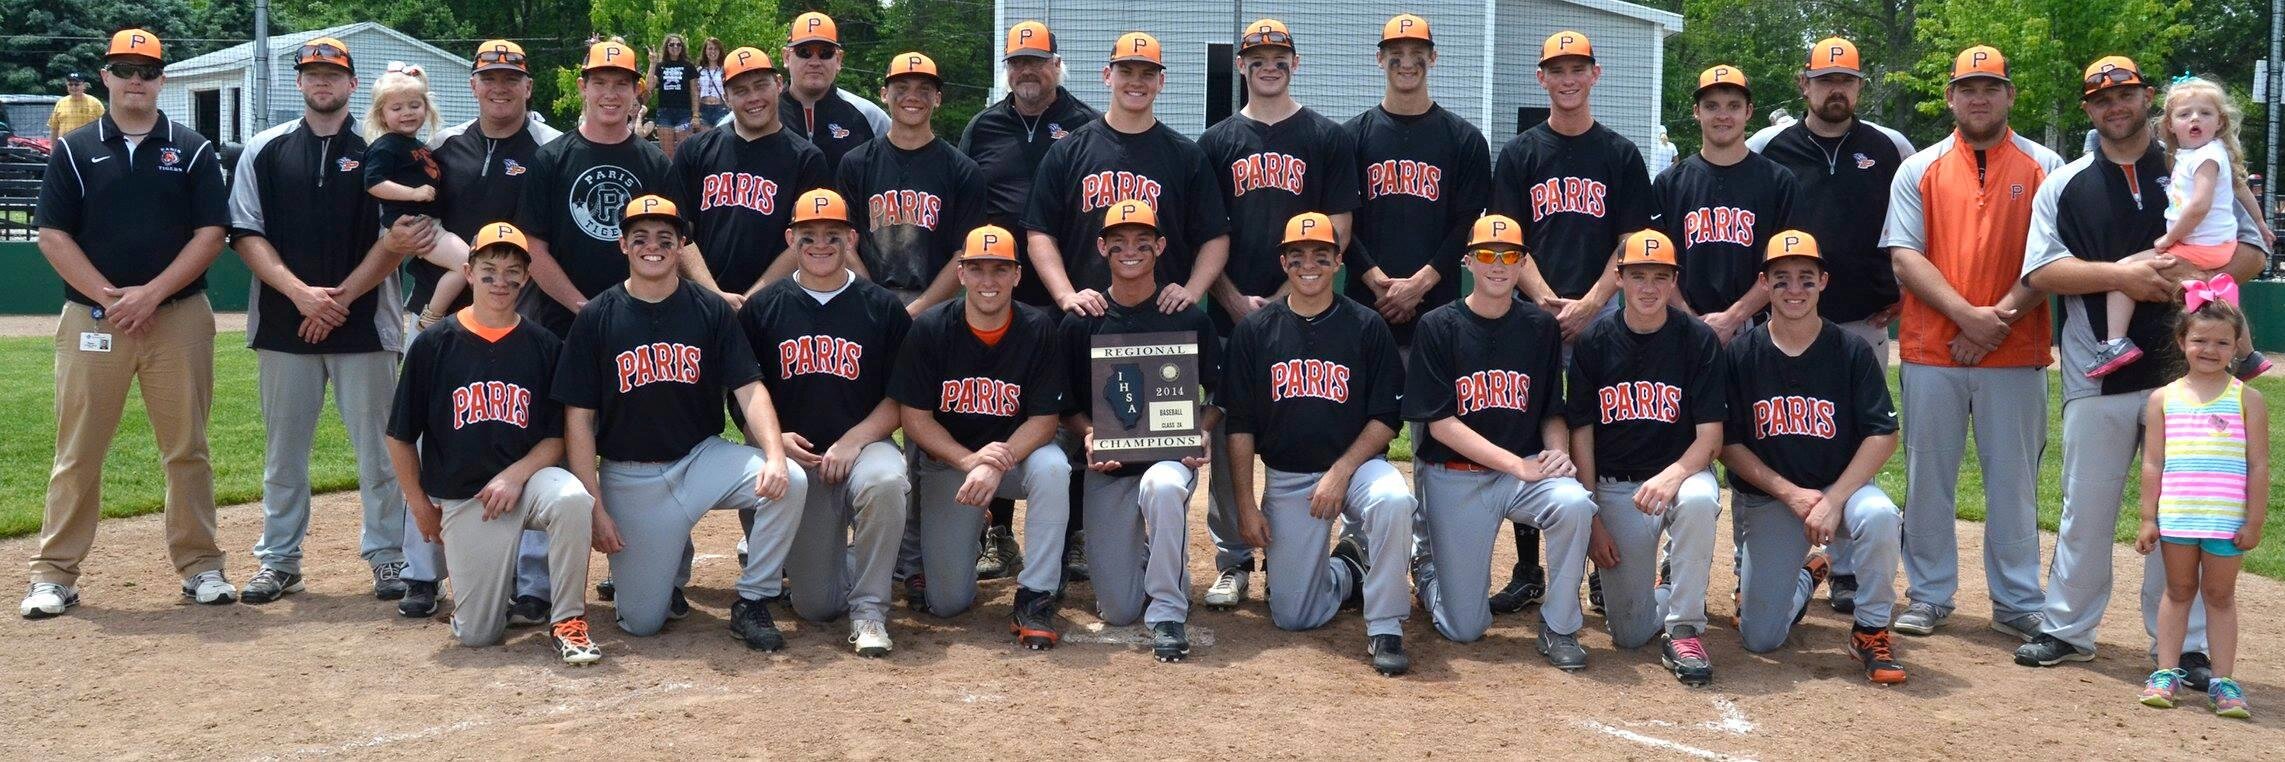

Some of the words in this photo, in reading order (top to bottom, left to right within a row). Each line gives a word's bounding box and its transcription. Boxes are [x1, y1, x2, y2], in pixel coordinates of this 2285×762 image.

[808, 18, 820, 32] P
[1400, 20, 1412, 33] P
[131, 35, 146, 48] P
[1020, 30, 1033, 44] P
[1134, 38, 1146, 52] P
[1560, 37, 1574, 50] P
[607, 47, 619, 61] P
[738, 51, 751, 66] P
[1830, 47, 1844, 62] P
[1973, 52, 1987, 67] P
[909, 56, 922, 70] P
[1715, 69, 1728, 82] P
[584, 170, 634, 188] PARIS
[1231, 152, 1307, 198] PARIS
[1368, 159, 1442, 202] PARIS
[700, 172, 778, 216] PARIS
[1082, 170, 1161, 213] PARIS
[1530, 176, 1606, 222] PARIS
[2010, 184, 2024, 200] P
[598, 187, 625, 222] P
[644, 199, 658, 212] P
[815, 198, 828, 214] P
[868, 190, 942, 231] PARIS
[1122, 205, 1136, 220] P
[499, 225, 512, 238] P
[1301, 219, 1316, 235] P
[1493, 221, 1506, 237] P
[1683, 206, 1756, 250] PARIS
[984, 235, 998, 251] P
[1645, 239, 1660, 256] P
[1784, 236, 1800, 252] P
[778, 335, 862, 380] PARIS
[1104, 346, 1186, 356] REGIONAL
[616, 342, 702, 394] PARIS
[1271, 358, 1350, 404] PARIS
[939, 378, 1020, 418] PARIS
[1156, 386, 1184, 396] 2014
[1455, 369, 1530, 416] PARIS
[452, 381, 531, 430] PARIS
[1599, 382, 1682, 424] PARIS
[1752, 396, 1836, 440] PARIS
[1100, 436, 1196, 448] CHAMPIONS
